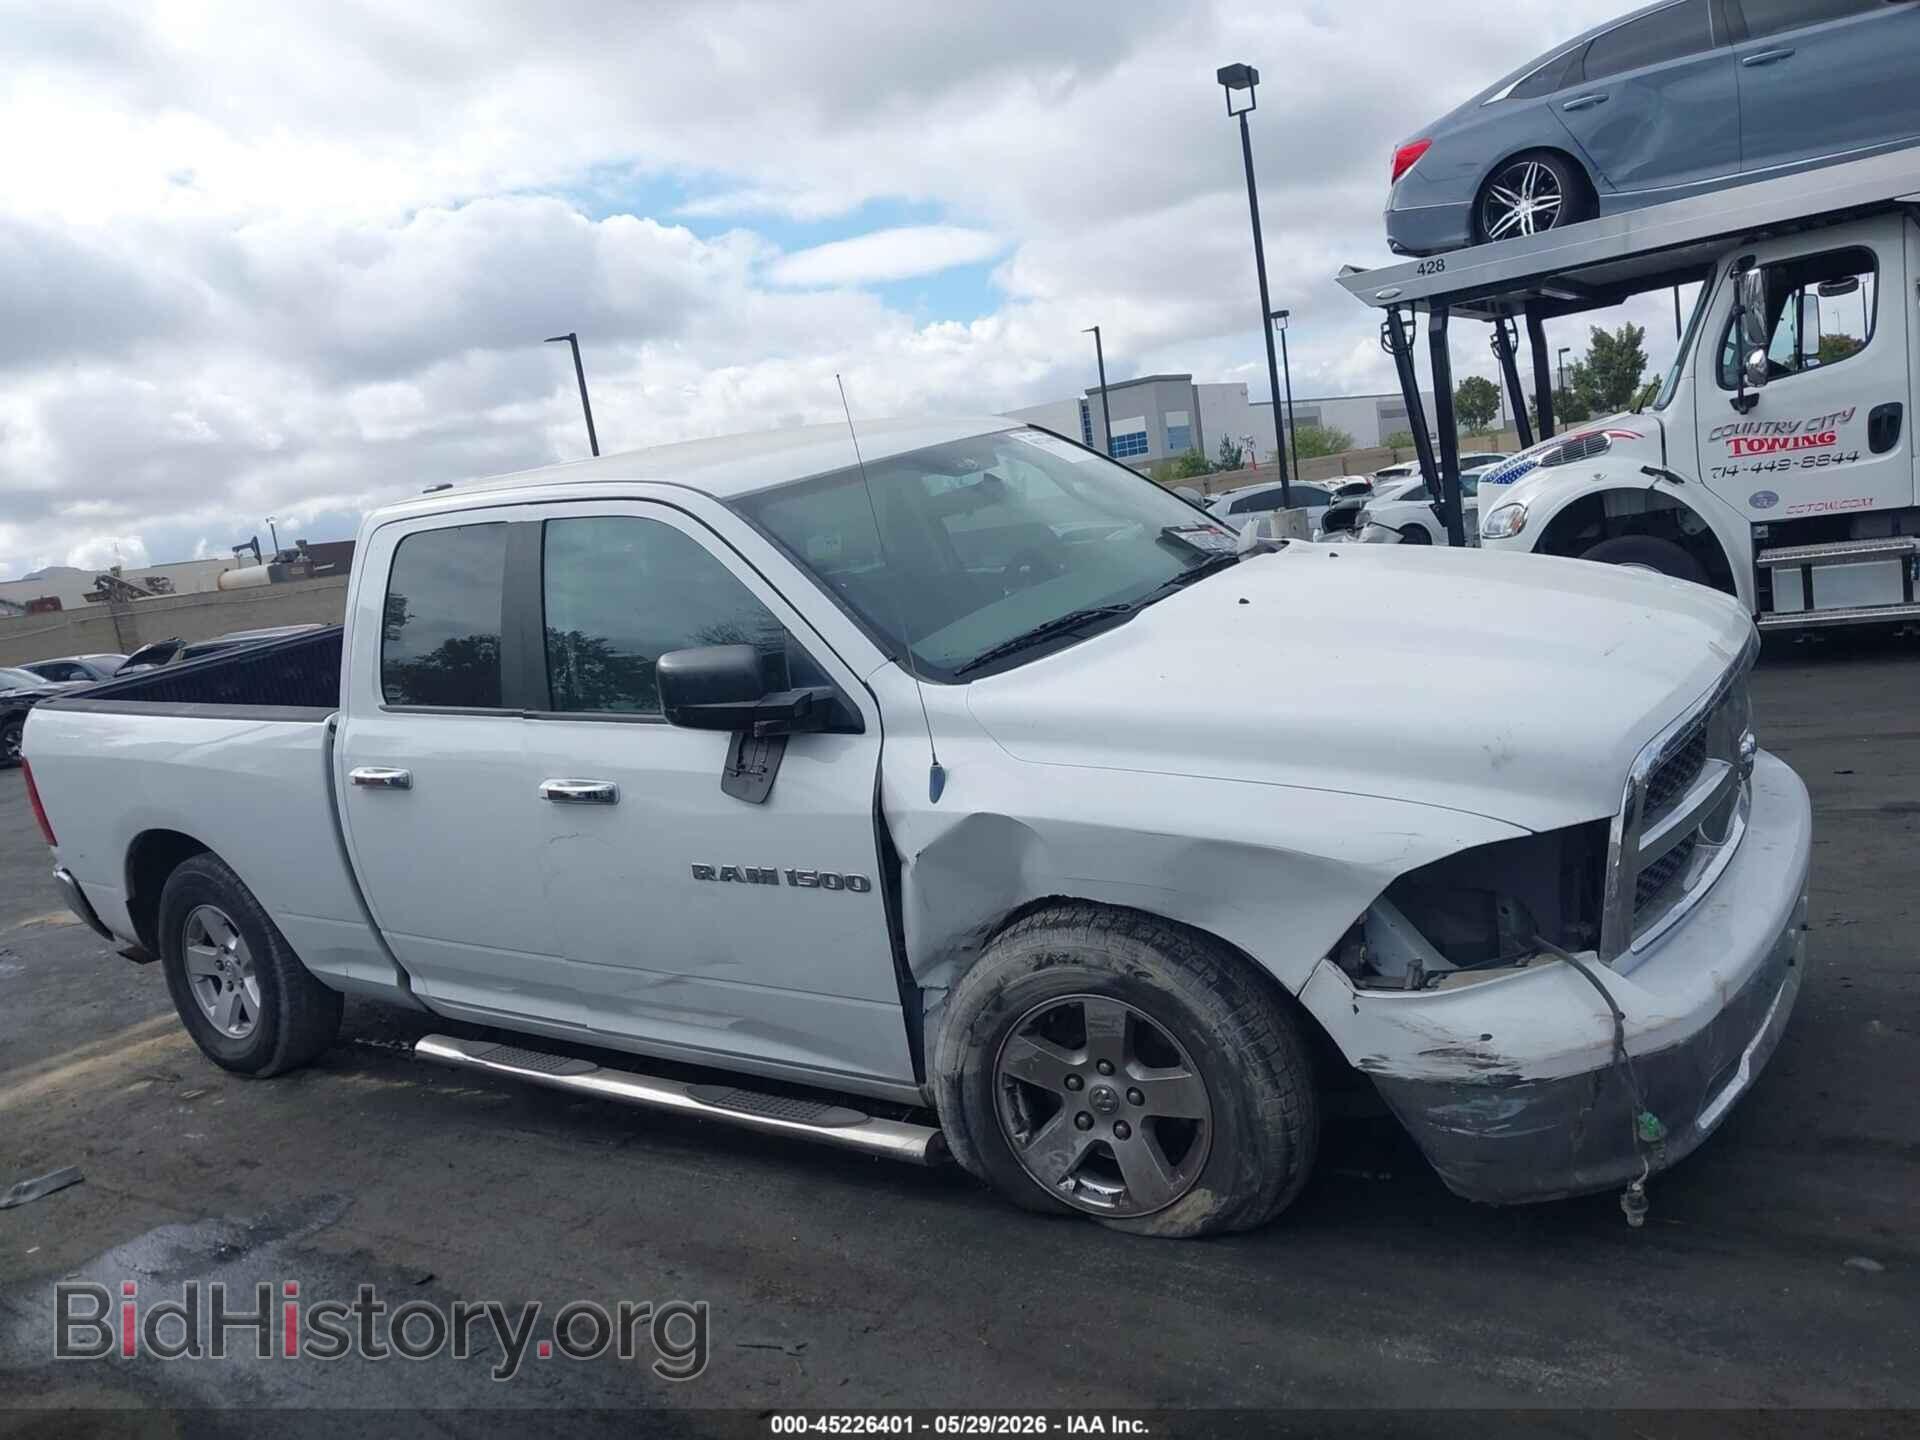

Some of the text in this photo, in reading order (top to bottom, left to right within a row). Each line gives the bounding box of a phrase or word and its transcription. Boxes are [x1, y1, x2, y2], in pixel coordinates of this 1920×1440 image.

[1417, 259, 1445, 275] 428
[1708, 406, 1856, 442] COUNTRY CITY
[1726, 430, 1837, 455] TOWING
[1710, 451, 1860, 479] 714-449-8844
[691, 863, 871, 893] RAM 1500
